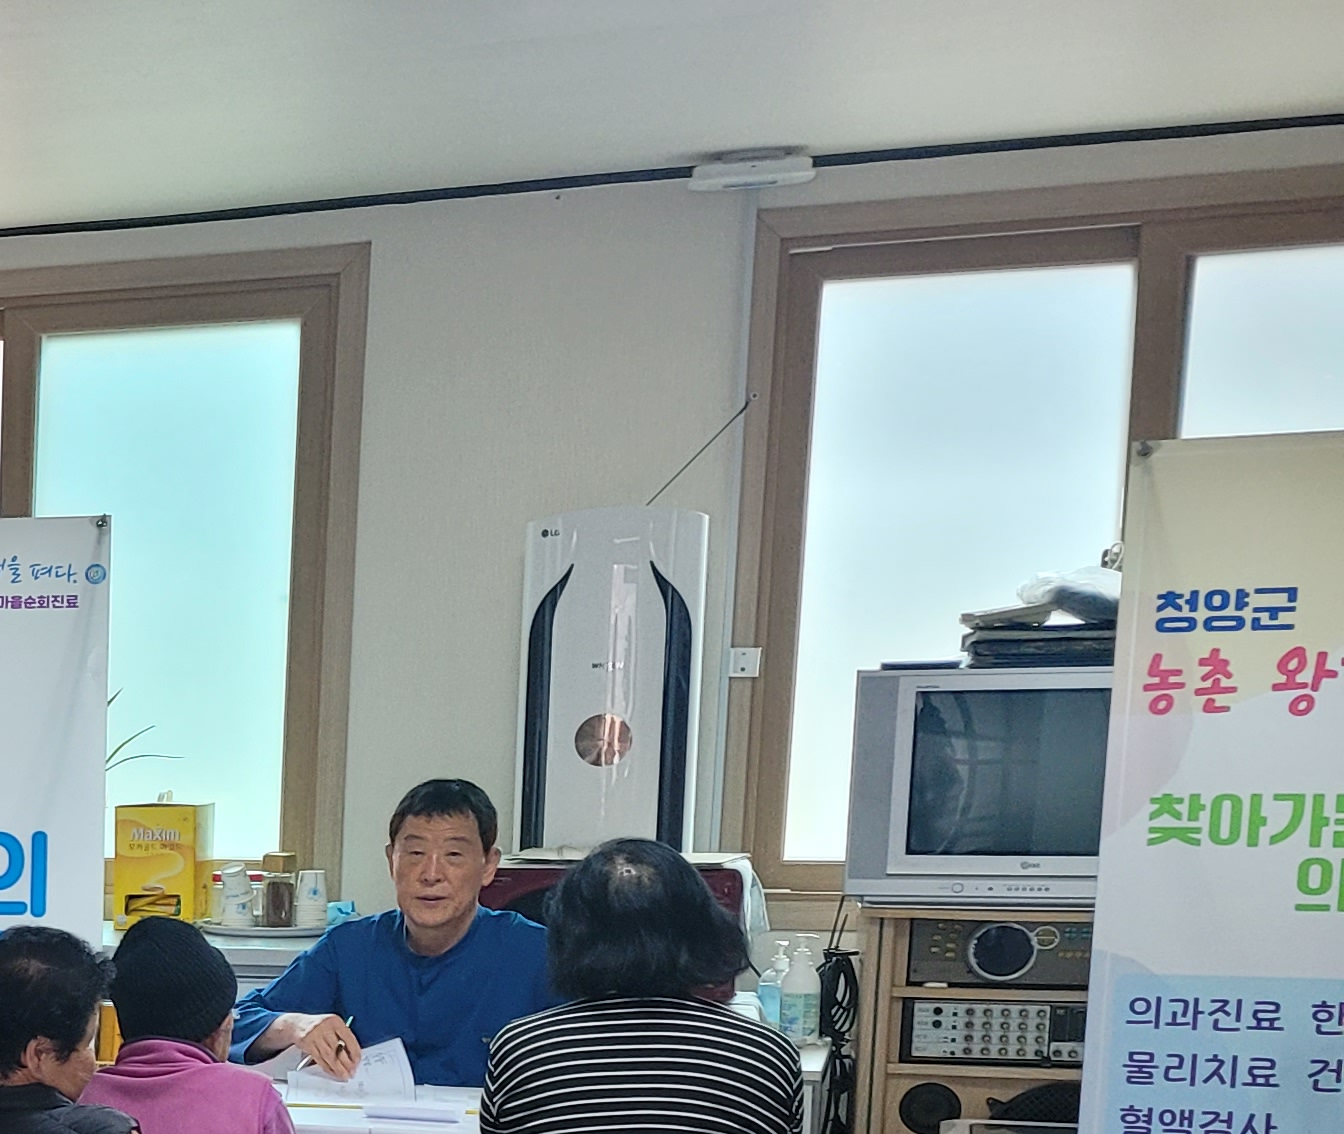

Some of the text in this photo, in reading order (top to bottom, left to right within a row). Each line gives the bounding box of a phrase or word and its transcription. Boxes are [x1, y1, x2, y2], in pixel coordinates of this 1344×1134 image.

[1155, 586, 1299, 634] 청양군
[1143, 645, 1344, 717] 농촌 왕
[130, 826, 181, 842] Maxim
[1125, 995, 1286, 1035] 의과진료
[1121, 1051, 1282, 1090] 물리치료
